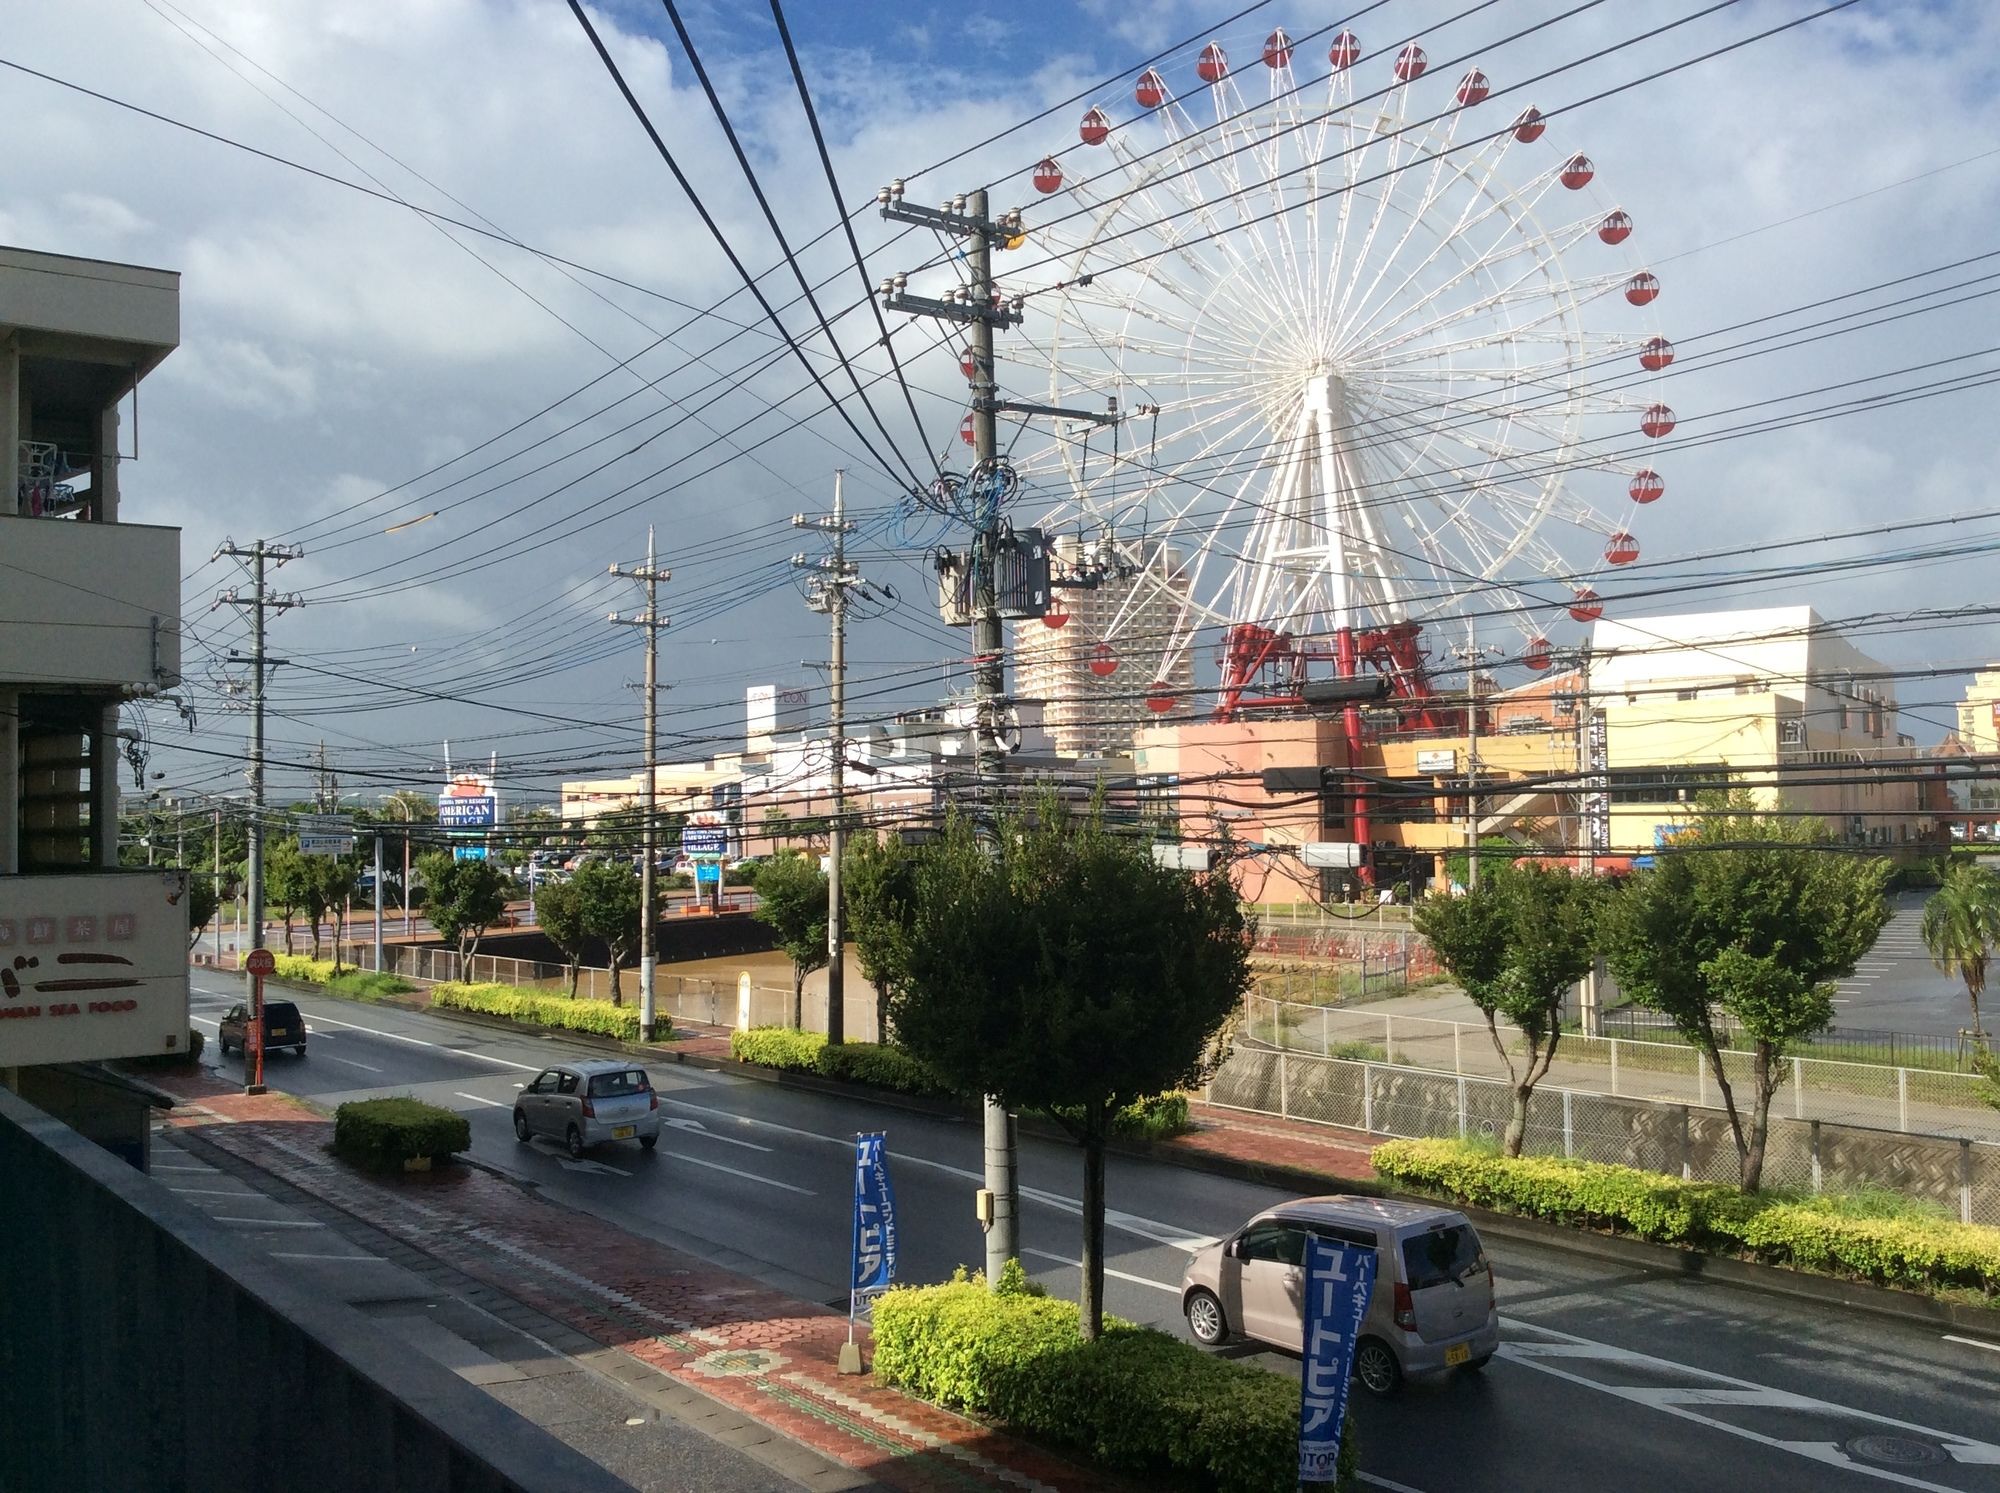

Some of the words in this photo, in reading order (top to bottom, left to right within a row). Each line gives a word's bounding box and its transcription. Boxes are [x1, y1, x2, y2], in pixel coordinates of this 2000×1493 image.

[440, 804, 490, 816] AMERICAN
[442, 816, 483, 826] VILLAGE
[49, 1003, 80, 1016] SEA
[88, 1000, 137, 1013] FOOD
[1303, 1247, 1347, 1433] ユートピア
